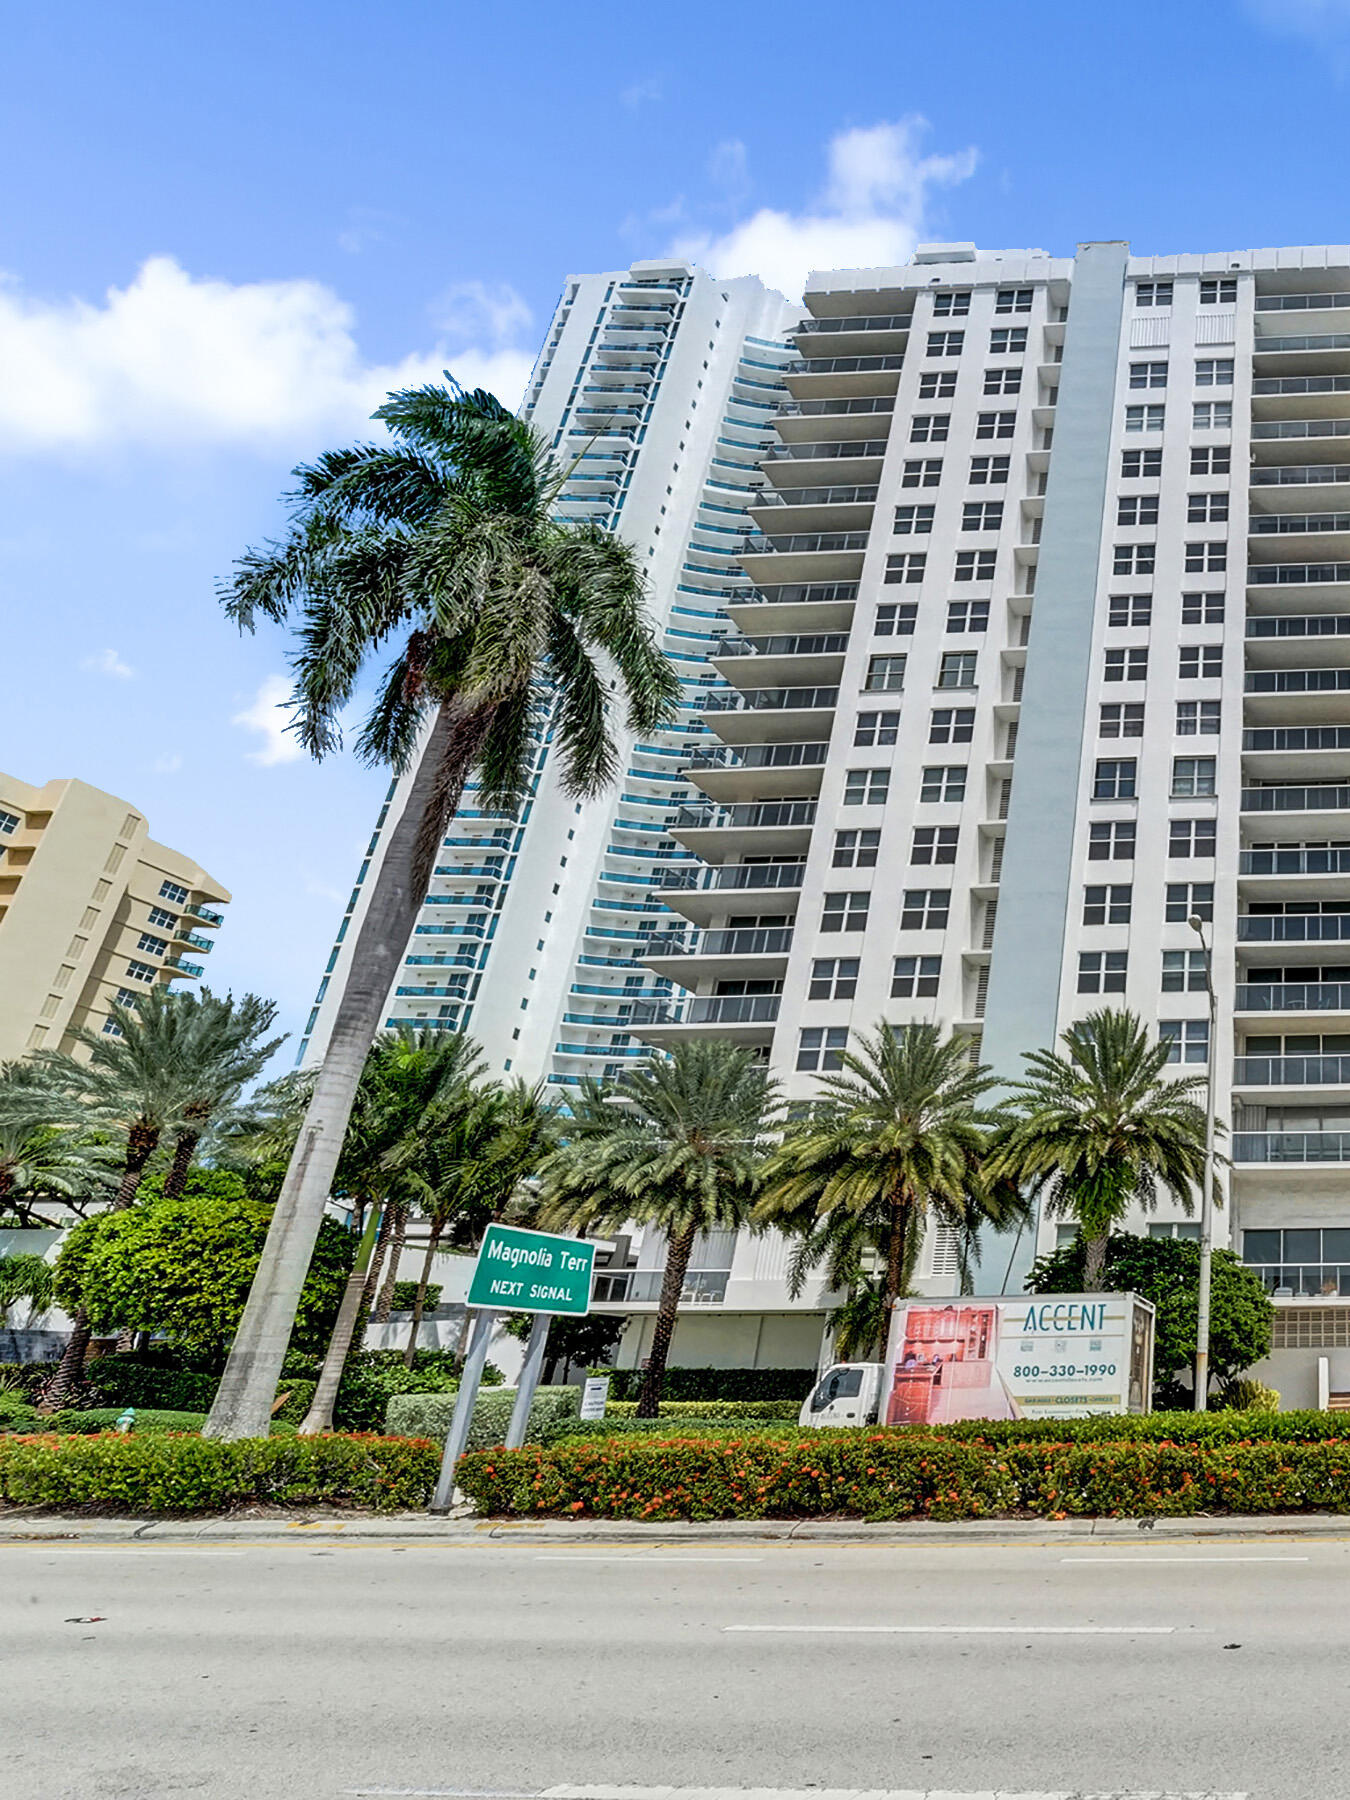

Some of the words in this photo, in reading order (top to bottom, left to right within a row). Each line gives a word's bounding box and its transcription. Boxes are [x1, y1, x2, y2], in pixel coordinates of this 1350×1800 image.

[487, 1239, 552, 1269] Magnolia
[560, 1250, 588, 1271] Terr
[489, 1279, 525, 1296] NEXT
[529, 1284, 573, 1301] SIGNAL
[1023, 1304, 1107, 1331] ACCENT
[1013, 1364, 1116, 1377] 800-330-1990
